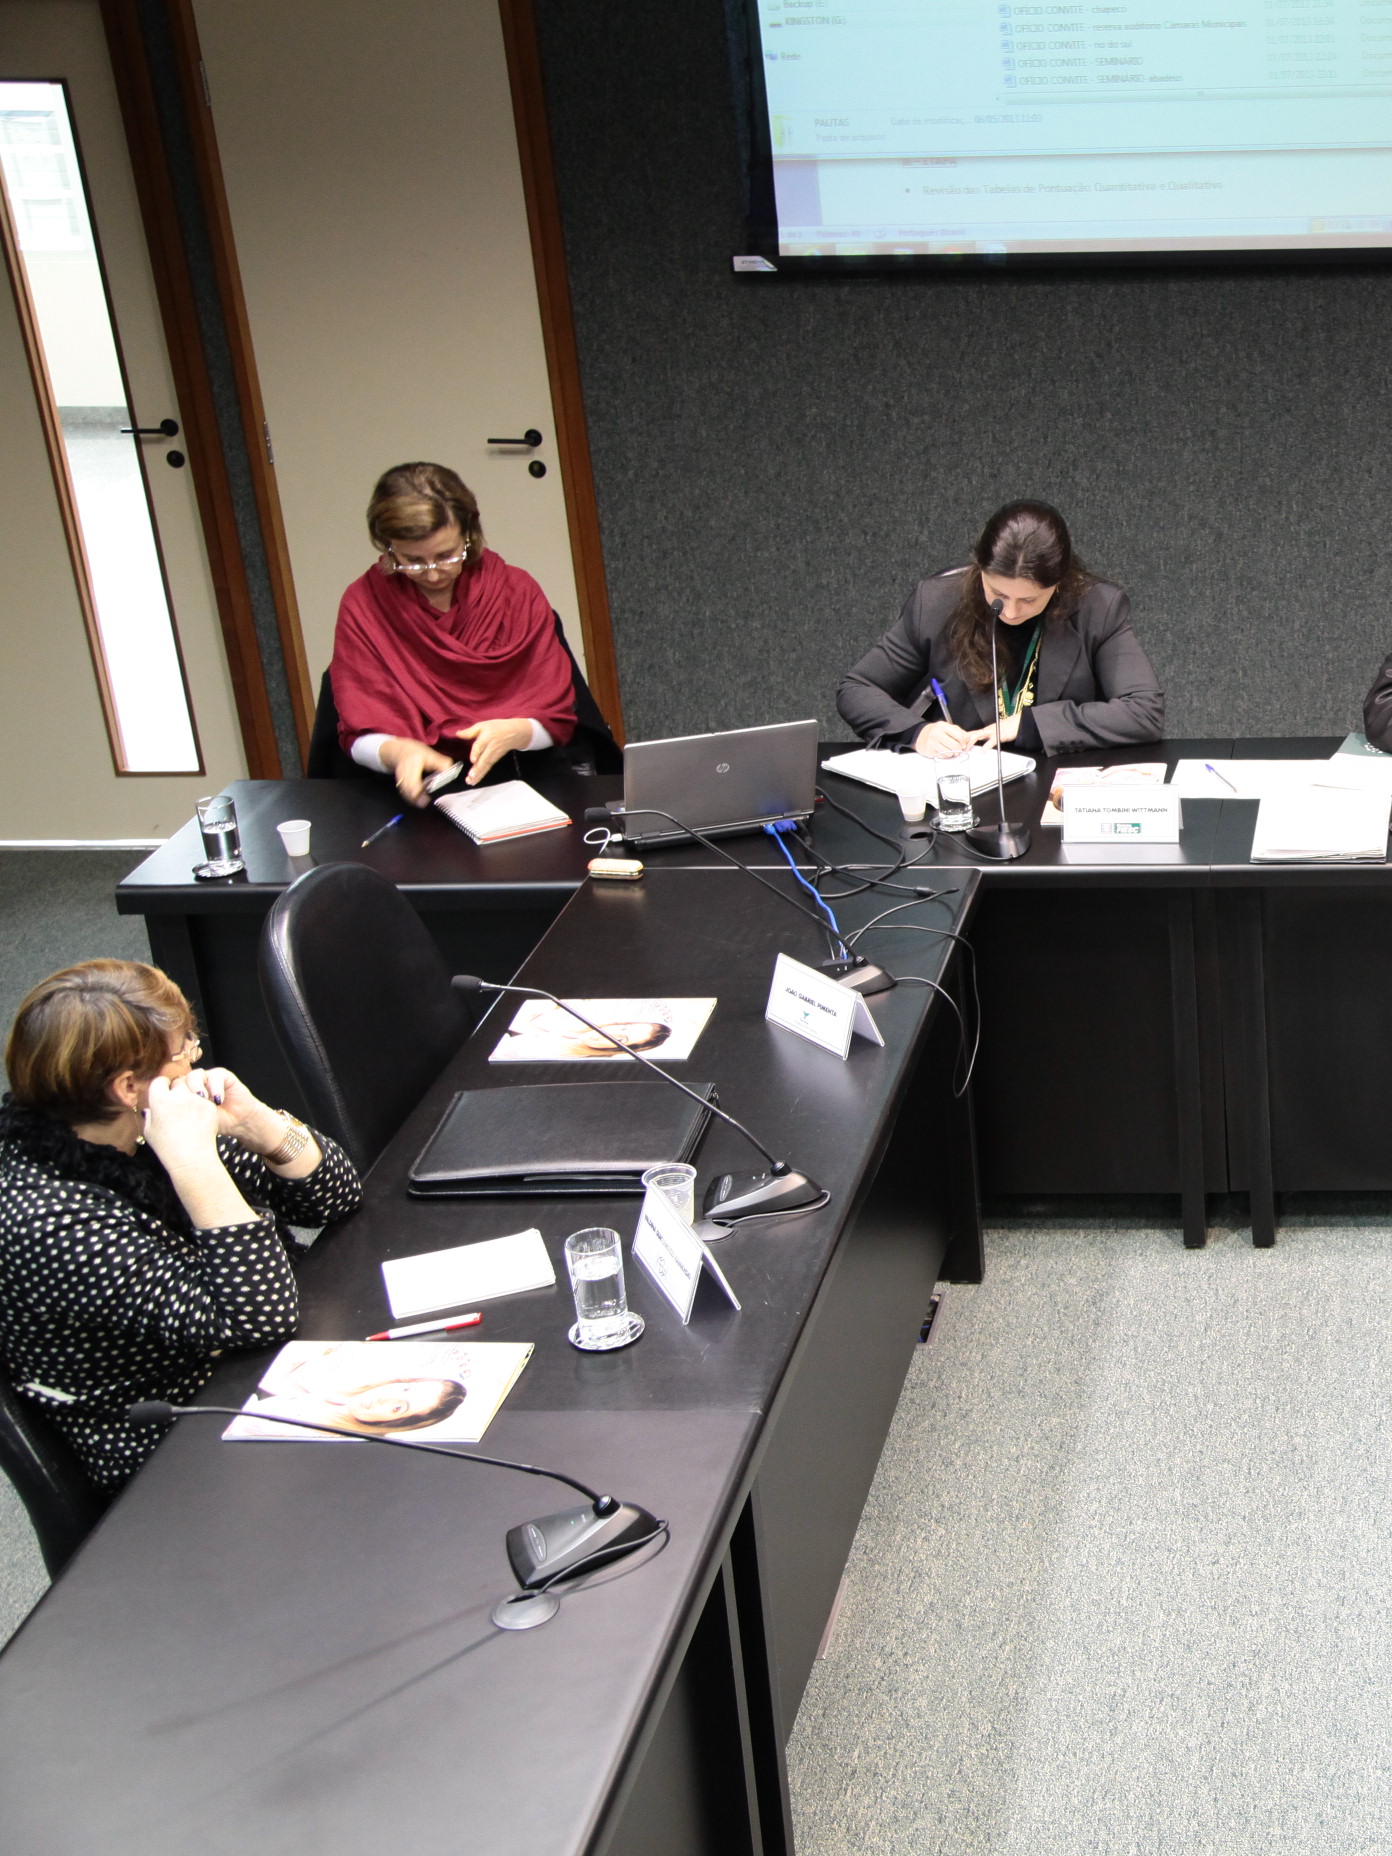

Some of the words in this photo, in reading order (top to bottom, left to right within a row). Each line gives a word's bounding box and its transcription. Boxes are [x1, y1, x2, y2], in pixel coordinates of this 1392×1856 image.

[1045, 5, 1083, 14] CONVITE
[785, 16, 830, 25] KINGSTON
[1046, 22, 1085, 32] CONVITE
[1048, 40, 1087, 50] CONVITE
[780, 51, 801, 61] Rede
[1049, 58, 1088, 67] CONVITE
[1050, 75, 1089, 85] CONVITE
[814, 118, 850, 127] PAUTAS
[923, 185, 962, 195] Revisão
[963, 185, 980, 195] das
[983, 184, 1022, 195] Tabelas
[1022, 184, 1036, 194] de
[1038, 183, 1091, 195] Pontuação
[1095, 182, 1156, 193] Quantitativa
[1167, 180, 1223, 191] Qualitativa
